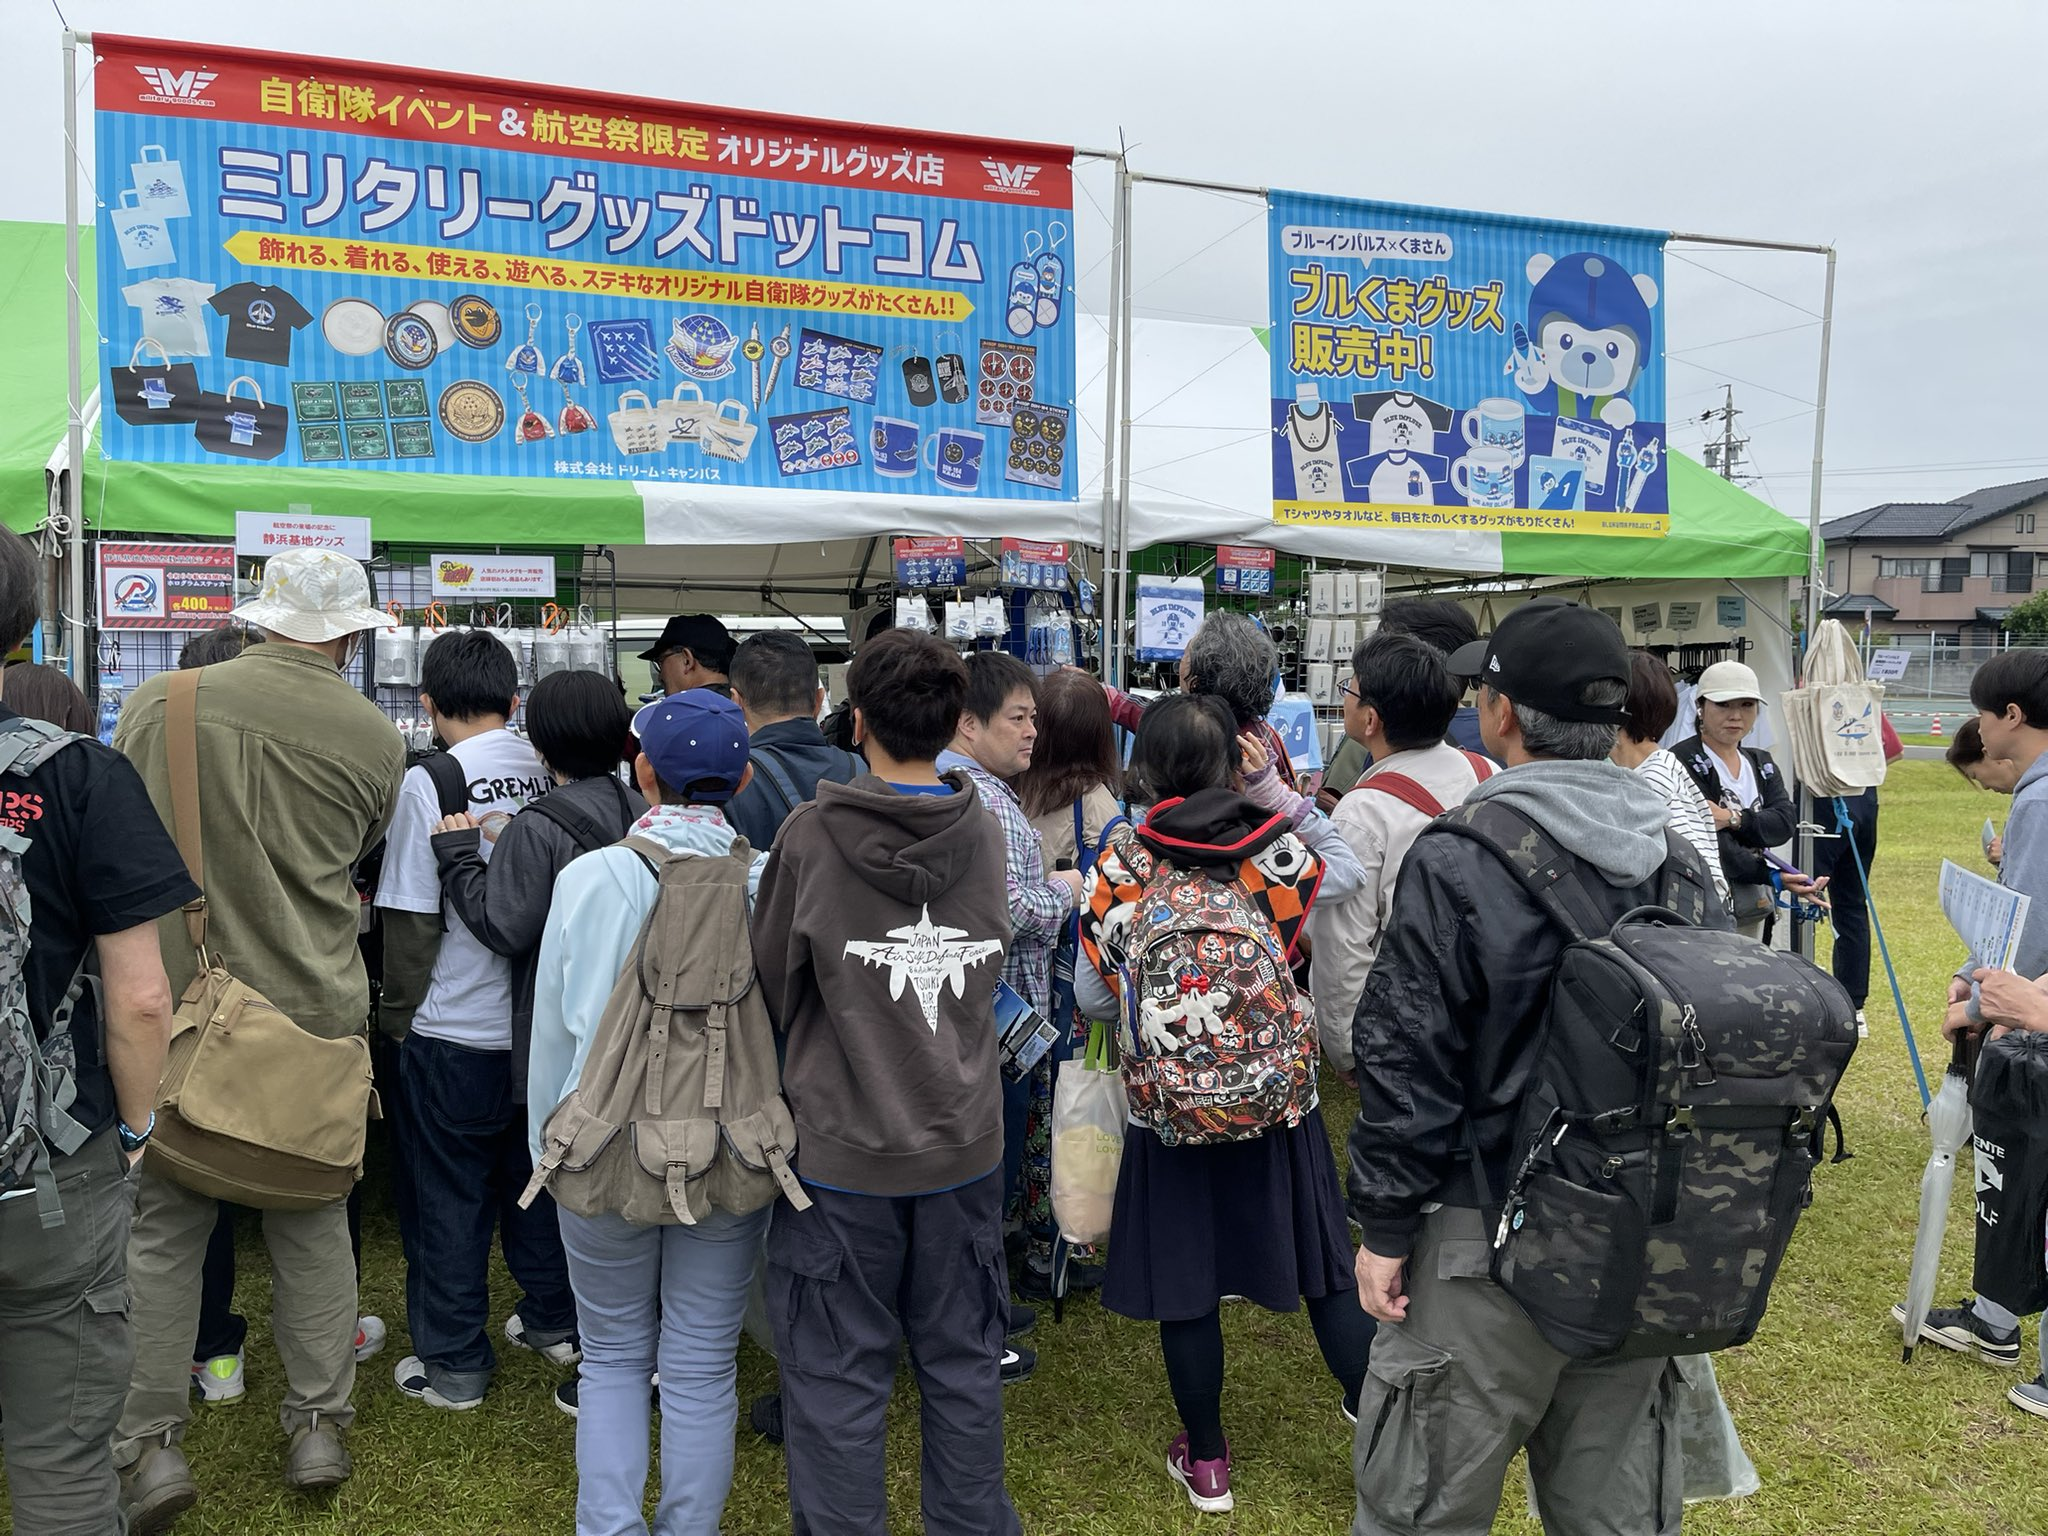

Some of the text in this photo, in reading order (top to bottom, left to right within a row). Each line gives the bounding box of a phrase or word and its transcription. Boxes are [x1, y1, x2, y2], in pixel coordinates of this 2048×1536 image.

[260, 77, 492, 134] 自衛隊イベント
[532, 108, 710, 161] 航空祭限定
[718, 135, 944, 187] オリジナルグッズ店
[220, 147, 984, 282] ミリタリーグッズドットコム
[1290, 232, 1447, 256] ブルーインパルス×くまさん
[1290, 264, 1503, 334] ブルくまグッズ
[554, 460, 721, 480] 株式会社 ドリーム・キャンバス
[263, 533, 346, 547] 静浜基地グッズ
[1294, 725, 1304, 741] 3
[910, 931, 940, 948] JAPAN
[1215, 975, 1238, 995] LEADER
[1244, 975, 1265, 1001] RULE
[1096, 1133, 1121, 1144] LOVE
[1096, 1145, 1121, 1156] LOVE
